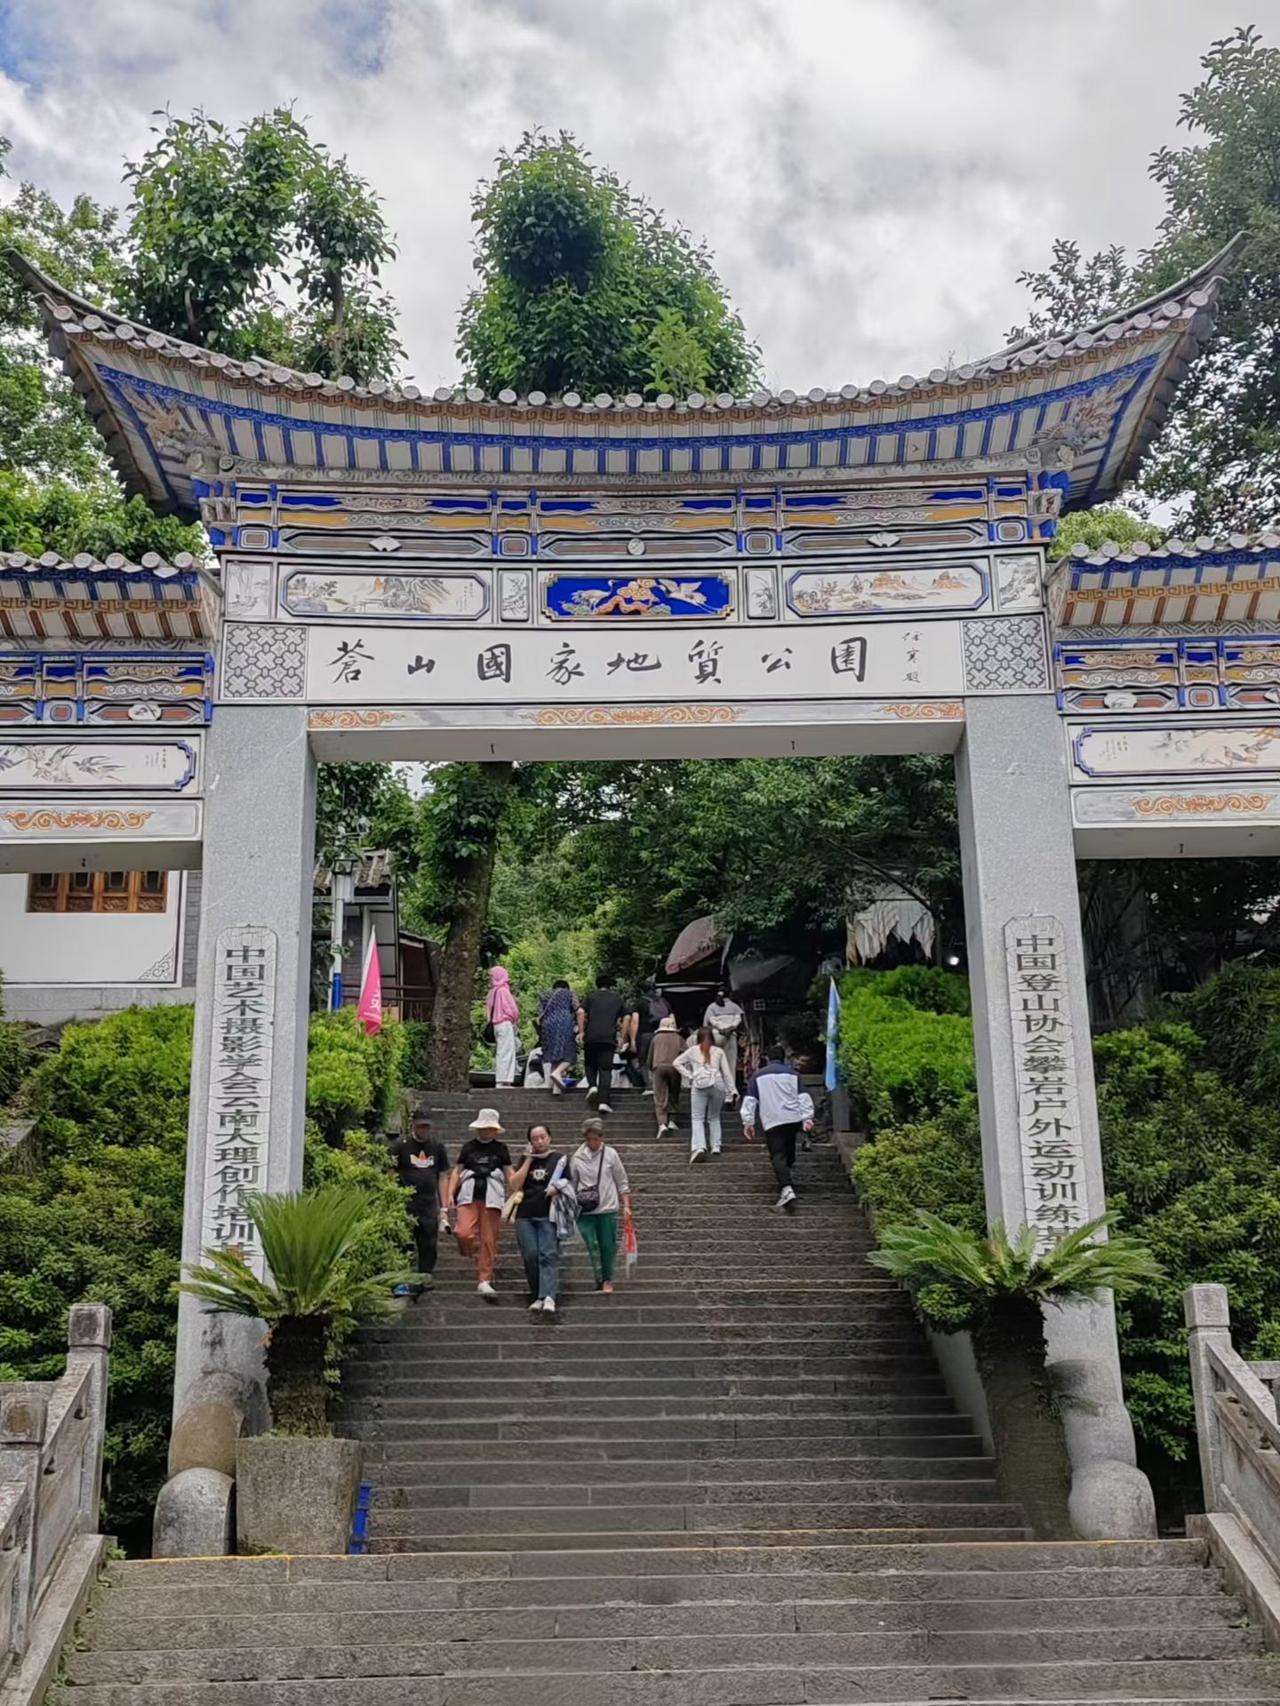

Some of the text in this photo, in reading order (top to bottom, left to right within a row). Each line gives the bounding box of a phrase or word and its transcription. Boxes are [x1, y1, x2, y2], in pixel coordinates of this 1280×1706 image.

[1015, 934, 1082, 1256] 中国登山协会攀岩户外运动训练基
